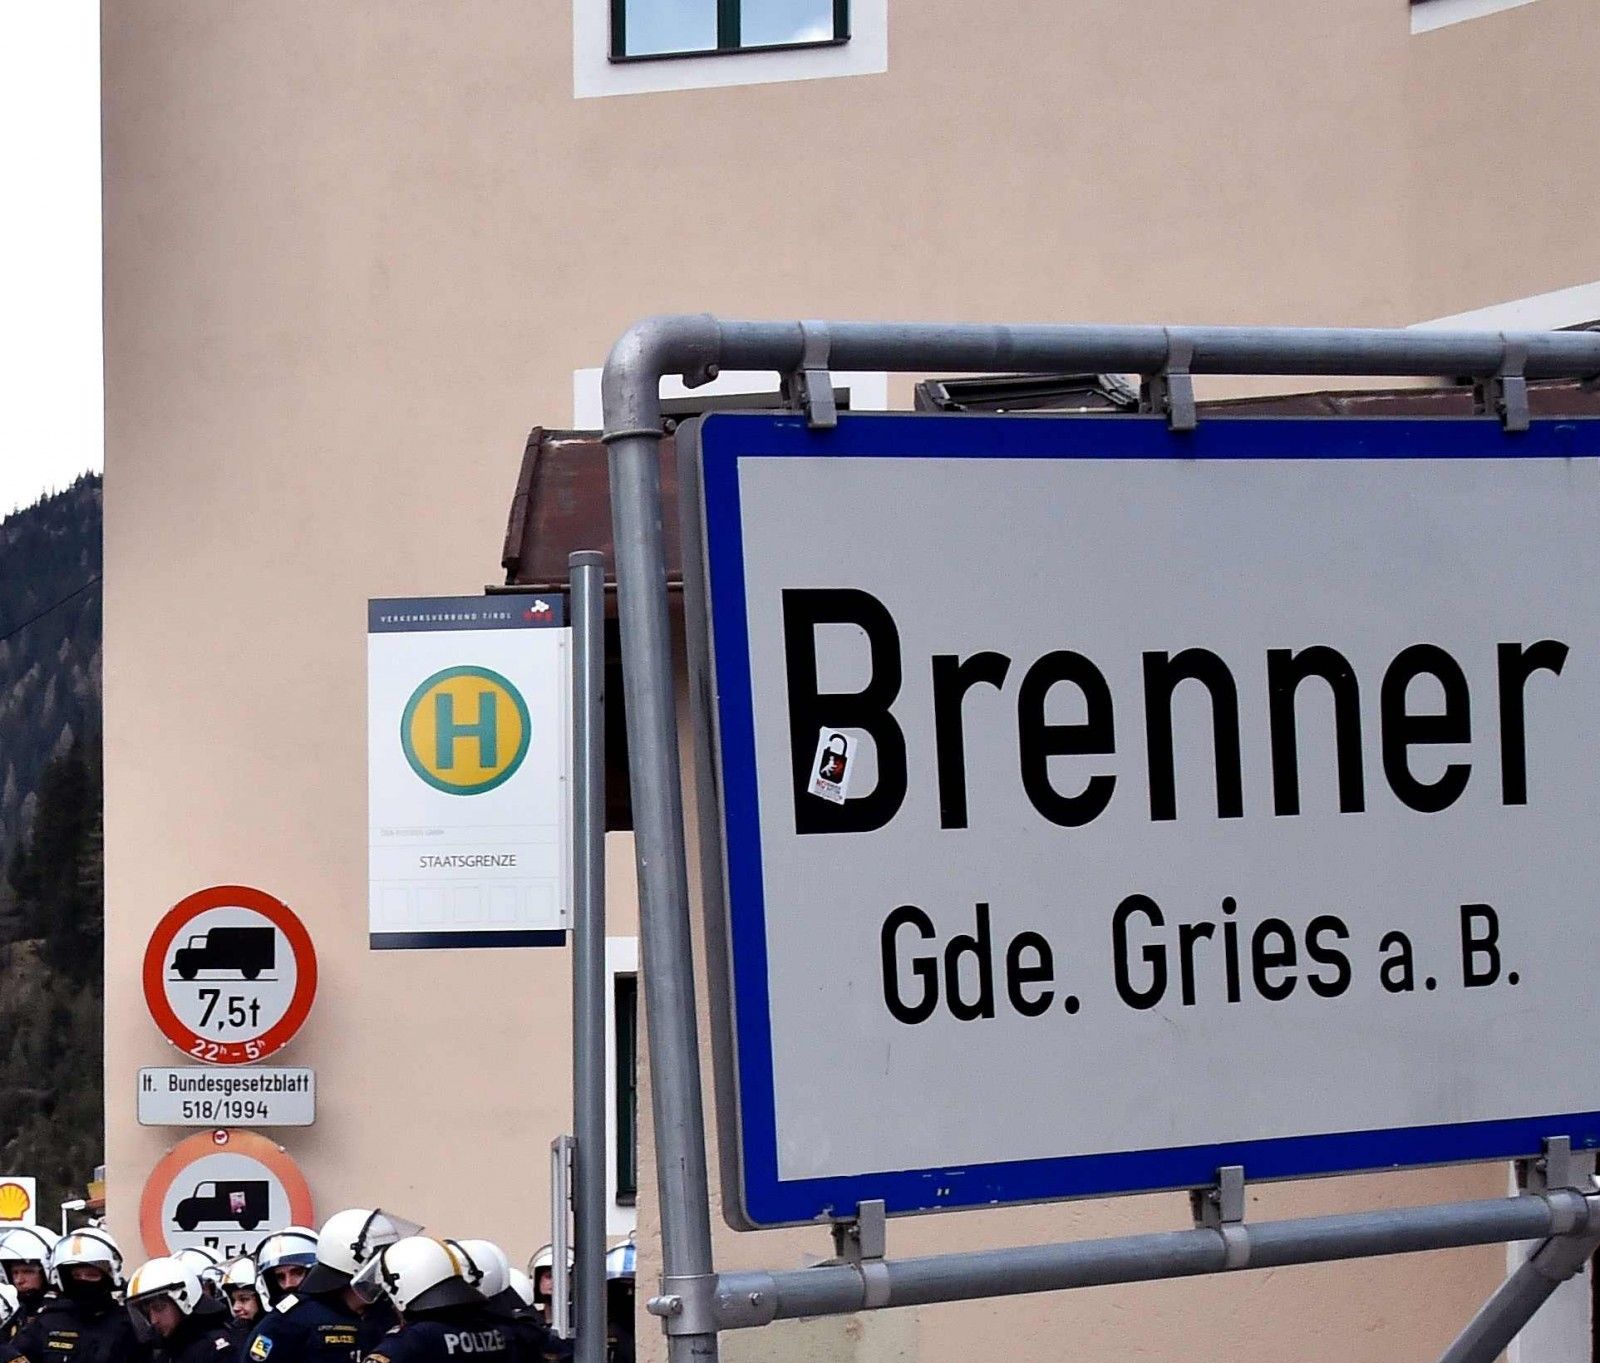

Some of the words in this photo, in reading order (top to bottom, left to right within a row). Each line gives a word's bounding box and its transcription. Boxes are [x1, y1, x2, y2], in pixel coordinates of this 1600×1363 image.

[483, 611, 512, 620] TIROL
[781, 587, 1570, 836] Brenner
[435, 691, 497, 770] H
[419, 854, 517, 868] STAATSGRENZE
[880, 903, 1080, 1026] Gde.
[1111, 892, 1352, 1010] Gries
[1377, 931, 1436, 993] a.
[1459, 903, 1521, 988] B.
[198, 988, 261, 1031] 7,5t
[168, 1074, 309, 1097] Bundesgesetzblatt
[182, 1099, 269, 1121] 518/1994
[443, 1329, 506, 1355] POLIZE
